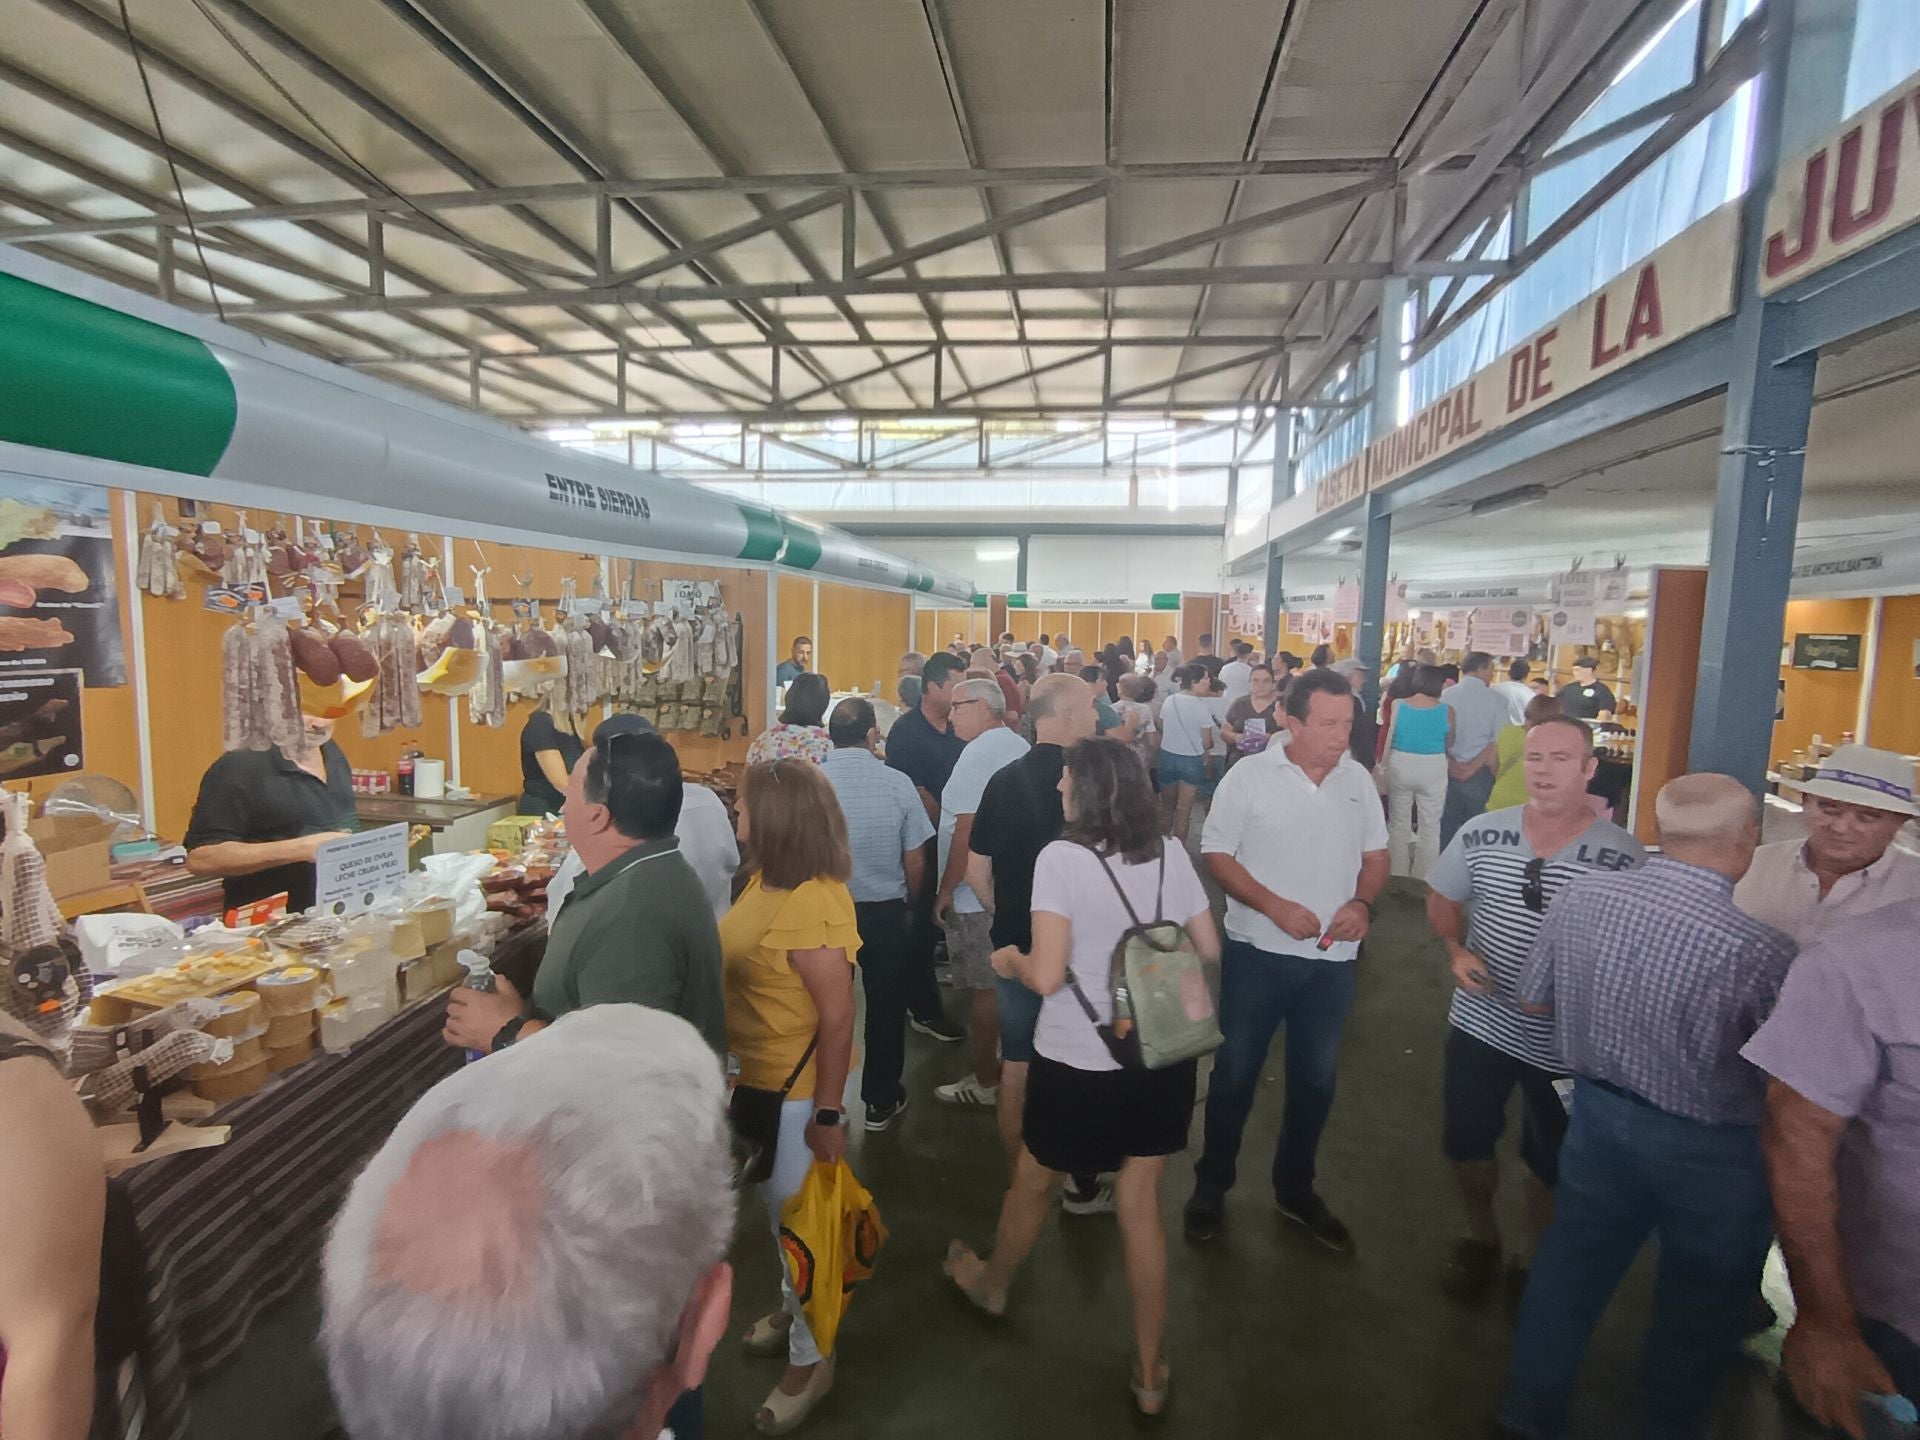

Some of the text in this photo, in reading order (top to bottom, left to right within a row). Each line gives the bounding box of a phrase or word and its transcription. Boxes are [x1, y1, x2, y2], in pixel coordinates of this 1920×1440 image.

[1317, 86, 1920, 512] CASETA MUNICIPAL DE LA JU
[545, 473, 651, 519] ENTRE SIERRAS
[1462, 829, 1520, 848] MON
[335, 871, 356, 882] LECHE
[358, 865, 379, 876] CRUDA
[381, 859, 398, 868] VIEJO
[339, 851, 393, 871] QUESO DE OVEJA
